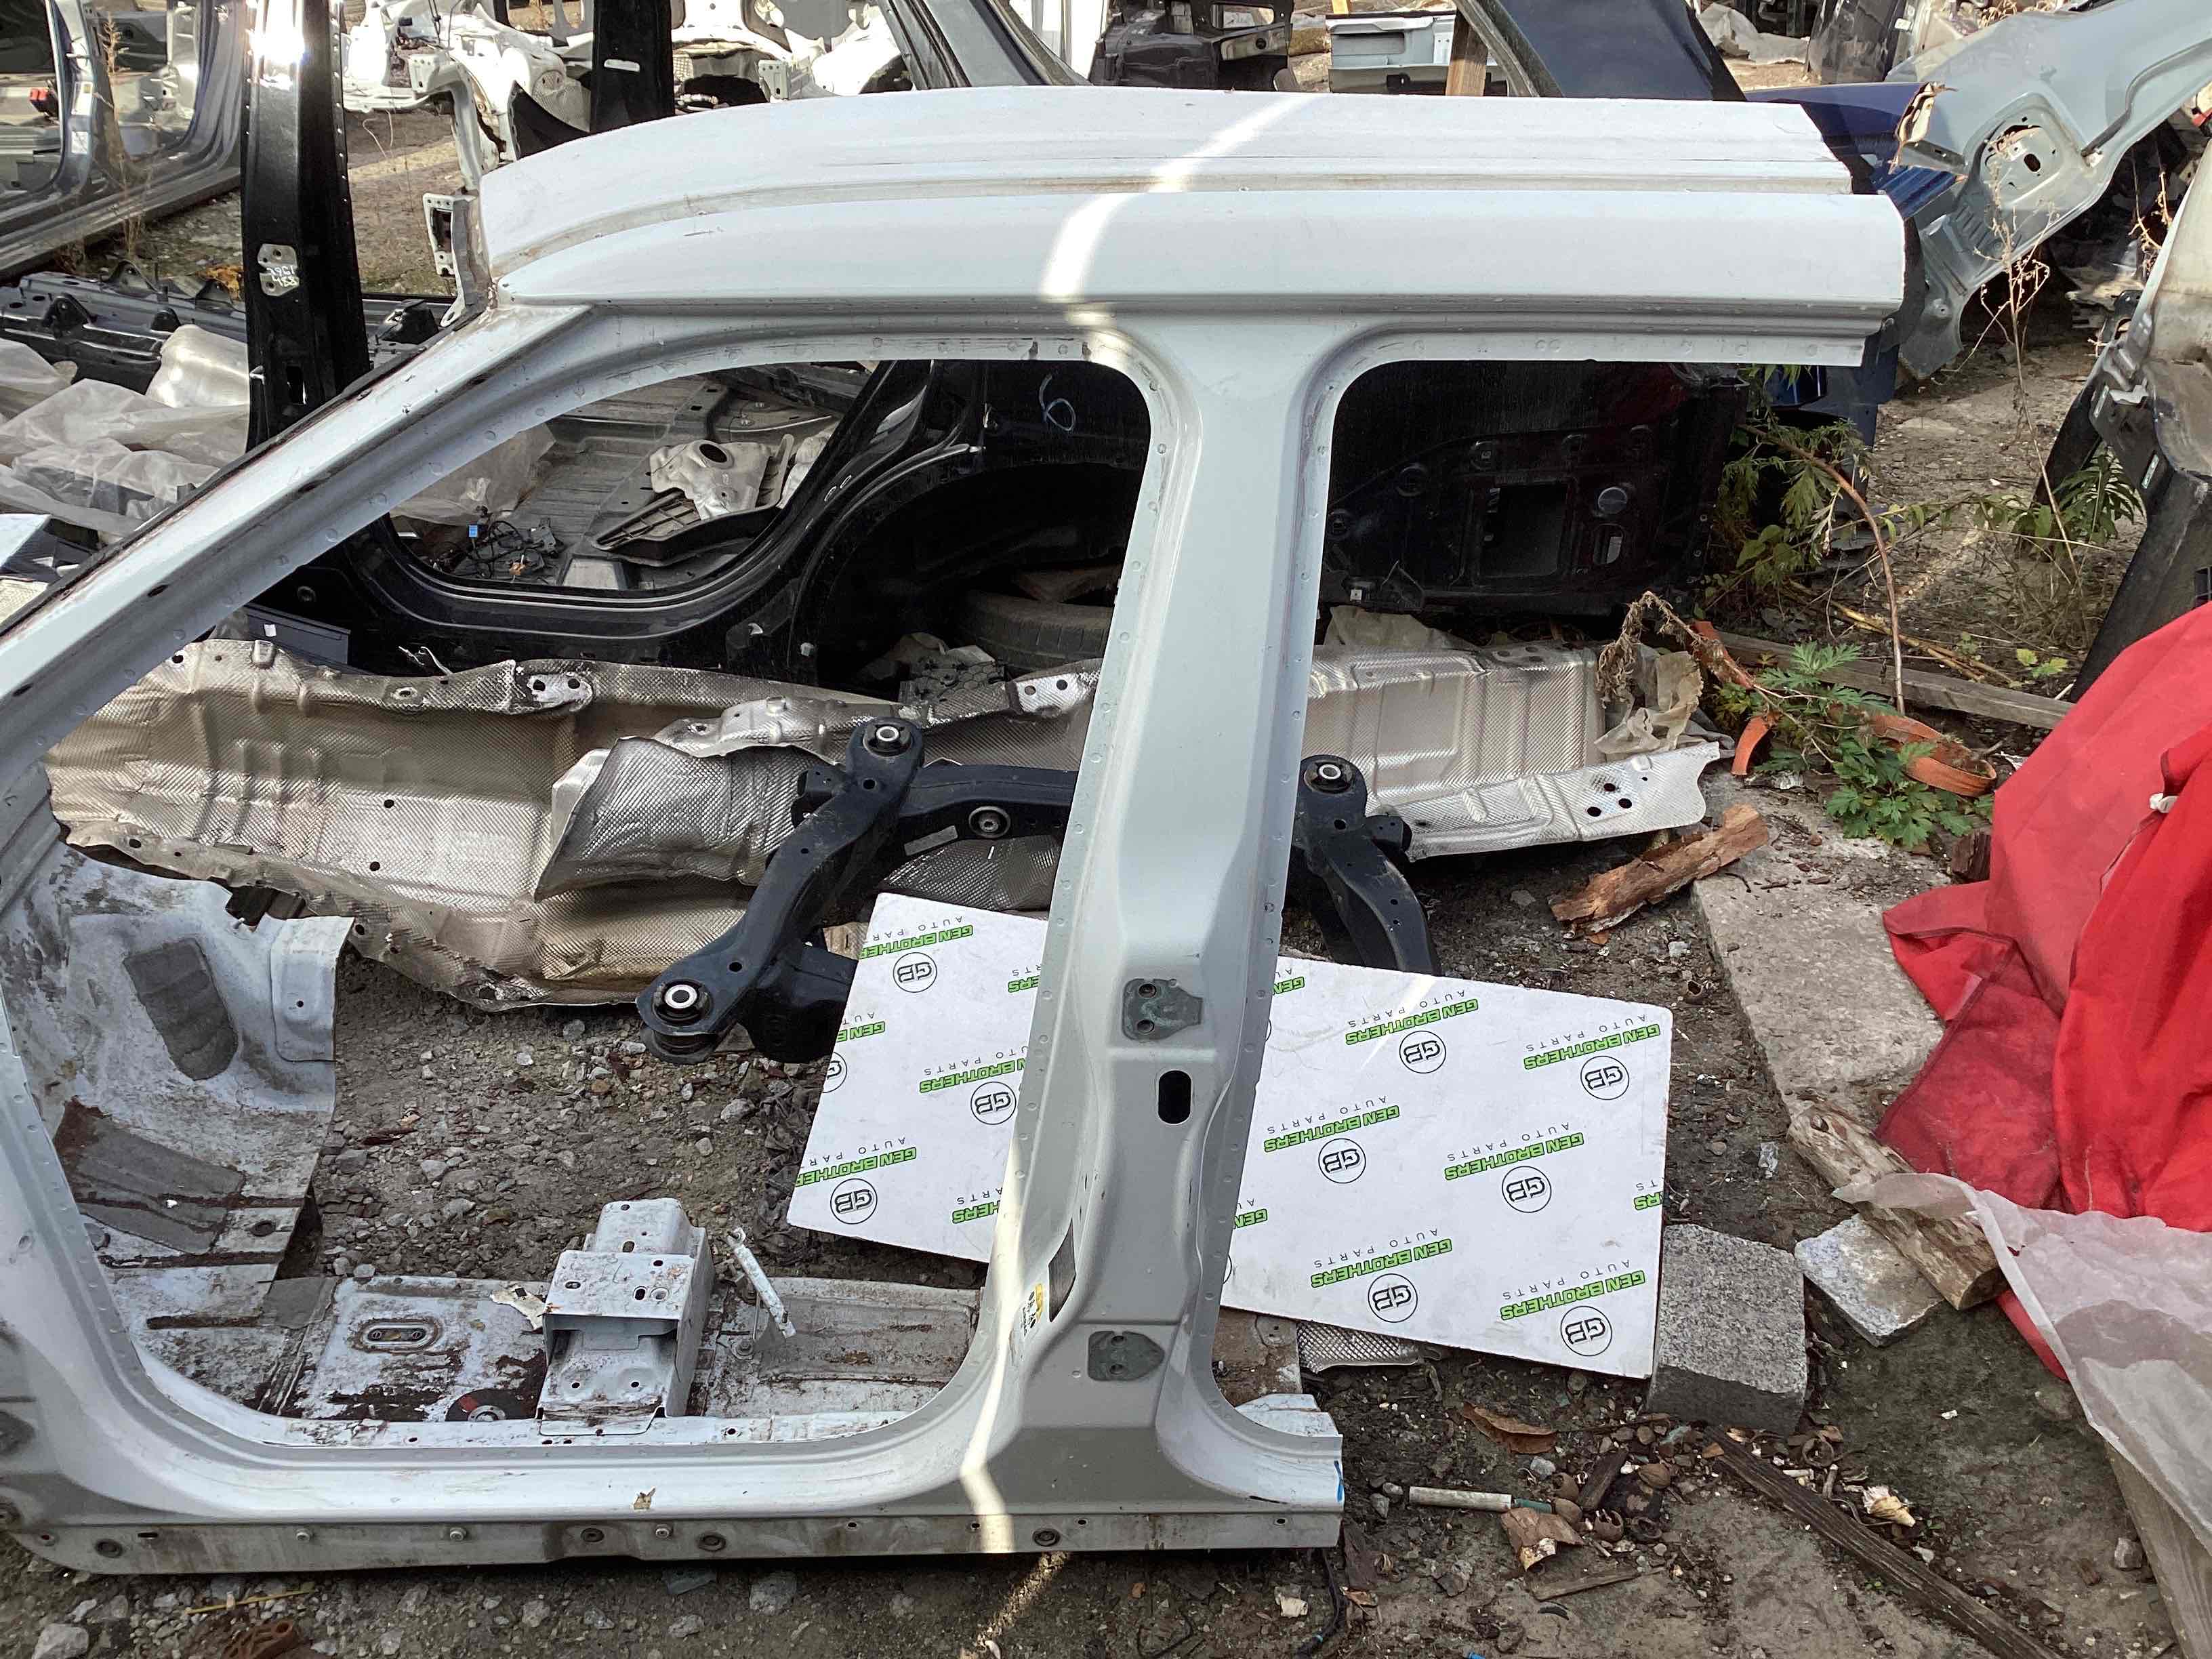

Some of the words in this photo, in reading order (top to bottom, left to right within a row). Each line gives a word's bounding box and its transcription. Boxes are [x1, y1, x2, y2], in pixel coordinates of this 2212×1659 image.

[918, 916, 962, 931] AUTO
[939, 924, 973, 943] GEN
[897, 962, 932, 983] GB
[1420, 990, 1464, 1008] AUTO
[1442, 999, 1479, 1019] GEN
[1345, 1008, 1441, 1045] BROTHERS
[1348, 1007, 1405, 1027] PARTS
[1599, 1015, 1645, 1032] AUTO
[850, 1021, 885, 1040] GEN
[1526, 1031, 1584, 1051] PARTS
[1622, 1024, 1660, 1044] GEN
[1404, 1040, 1440, 1064] GB
[1523, 1033, 1622, 1070] BROTHERS
[919, 1060, 1015, 1093] BROTHERS
[924, 1057, 981, 1076] PARTS
[1585, 1066, 1623, 1090] GB
[975, 1092, 1010, 1115] GB
[1340, 1096, 1386, 1114] AUTO
[1267, 1113, 1326, 1134] PARTS
[1362, 1105, 1399, 1126] GEN
[1264, 1115, 1361, 1153] BROTHERS
[1522, 1122, 1568, 1141] AUTO
[859, 1137, 905, 1154] AUTO
[1448, 1140, 1507, 1161] PARTS
[1545, 1132, 1584, 1153] GEN
[880, 1147, 916, 1167] GEN
[1322, 1149, 1360, 1173] GB
[1444, 1143, 1544, 1181] BROTHERS
[1506, 1176, 1545, 1202] GB
[834, 1189, 874, 1214] GB
[1389, 1229, 1437, 1247] AUTO
[1314, 1246, 1374, 1268] PARTS
[1413, 1238, 1452, 1261] GEN
[1311, 1249, 1412, 1288] BROTHERS
[1580, 1260, 1629, 1279] AUTO
[1503, 1277, 1565, 1300] PARTS
[1605, 1270, 1645, 1293] GEN
[1372, 1285, 1412, 1311] GB
[1500, 1280, 1605, 1321] BROTHERS
[1565, 1317, 1605, 1345] GB
